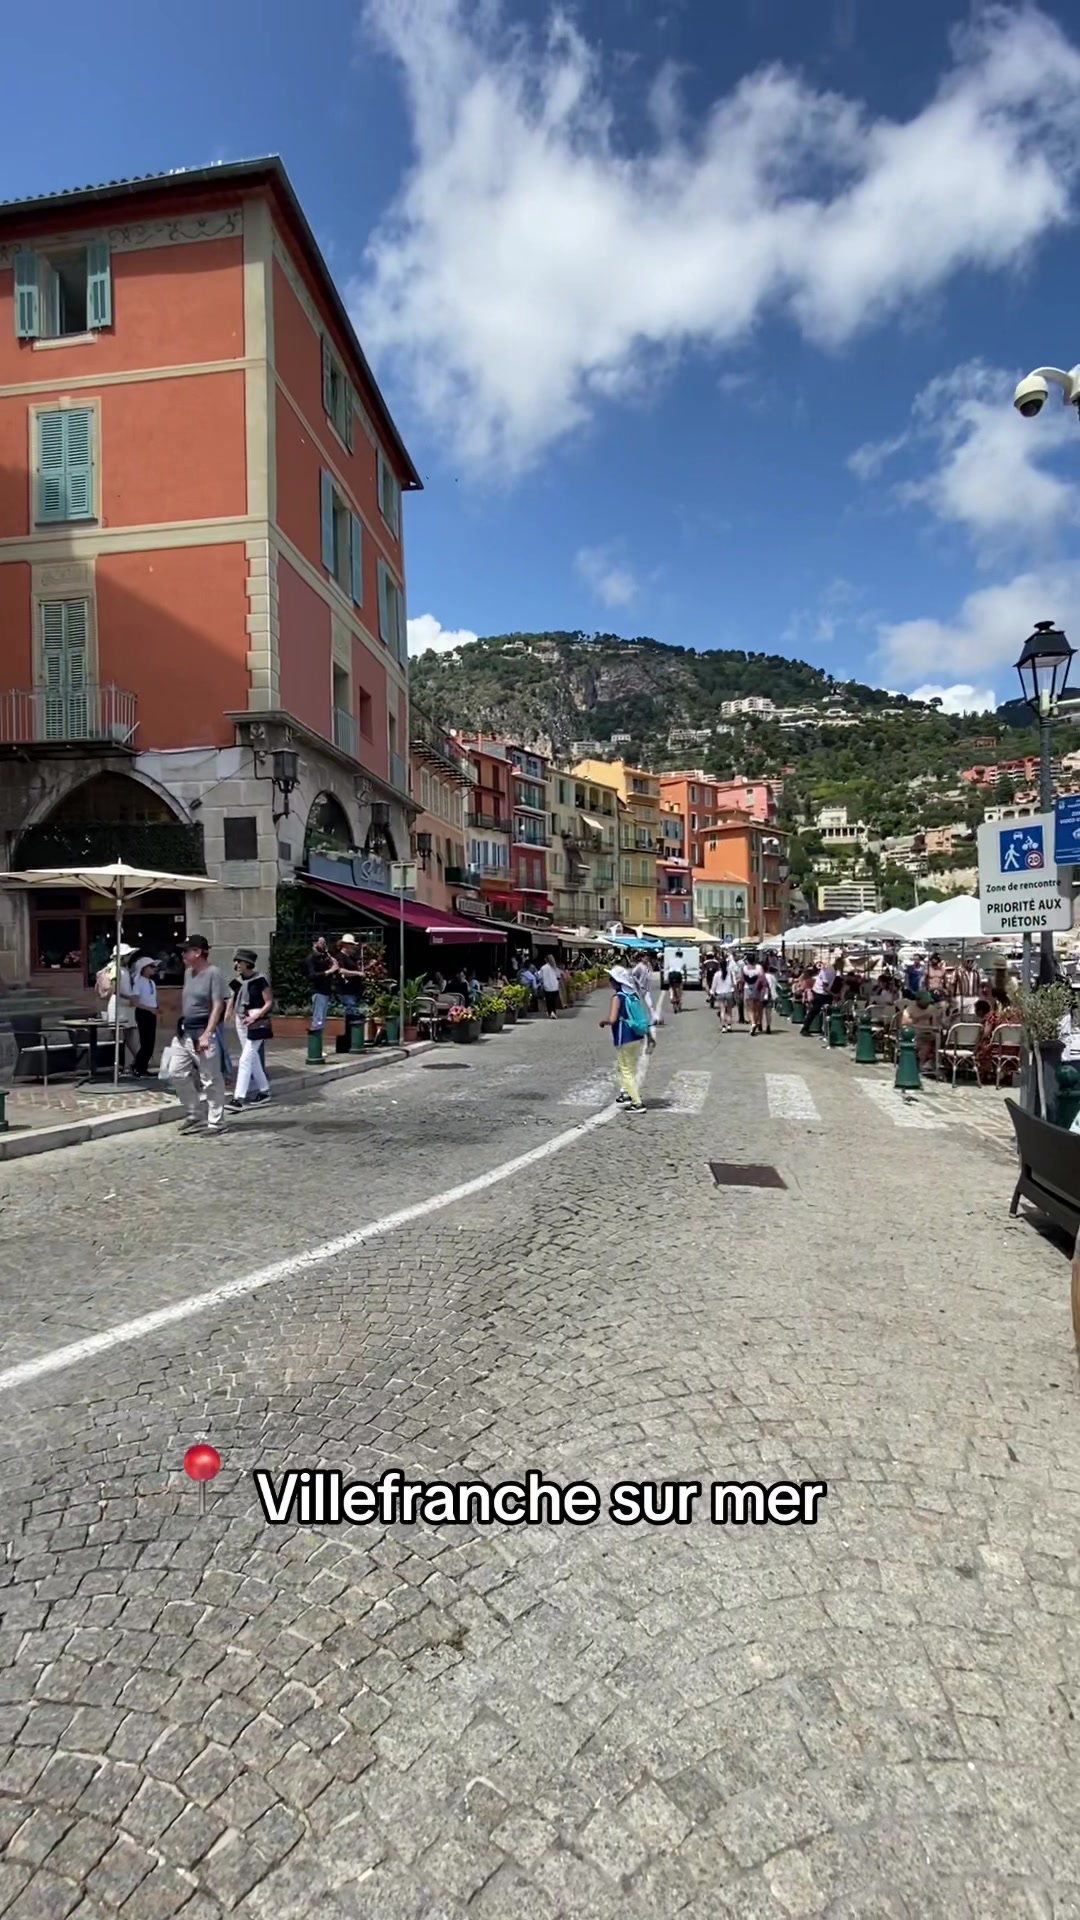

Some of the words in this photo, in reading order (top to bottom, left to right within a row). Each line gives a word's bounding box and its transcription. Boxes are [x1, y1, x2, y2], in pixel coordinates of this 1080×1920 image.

[987, 885, 1006, 893] Zone
[1008, 882, 1018, 891] de
[1020, 879, 1061, 889] rencontre
[987, 898, 1035, 913] PRIORITÉ
[1038, 898, 1061, 910] AUX
[1001, 915, 1047, 927] PIÉTONS
